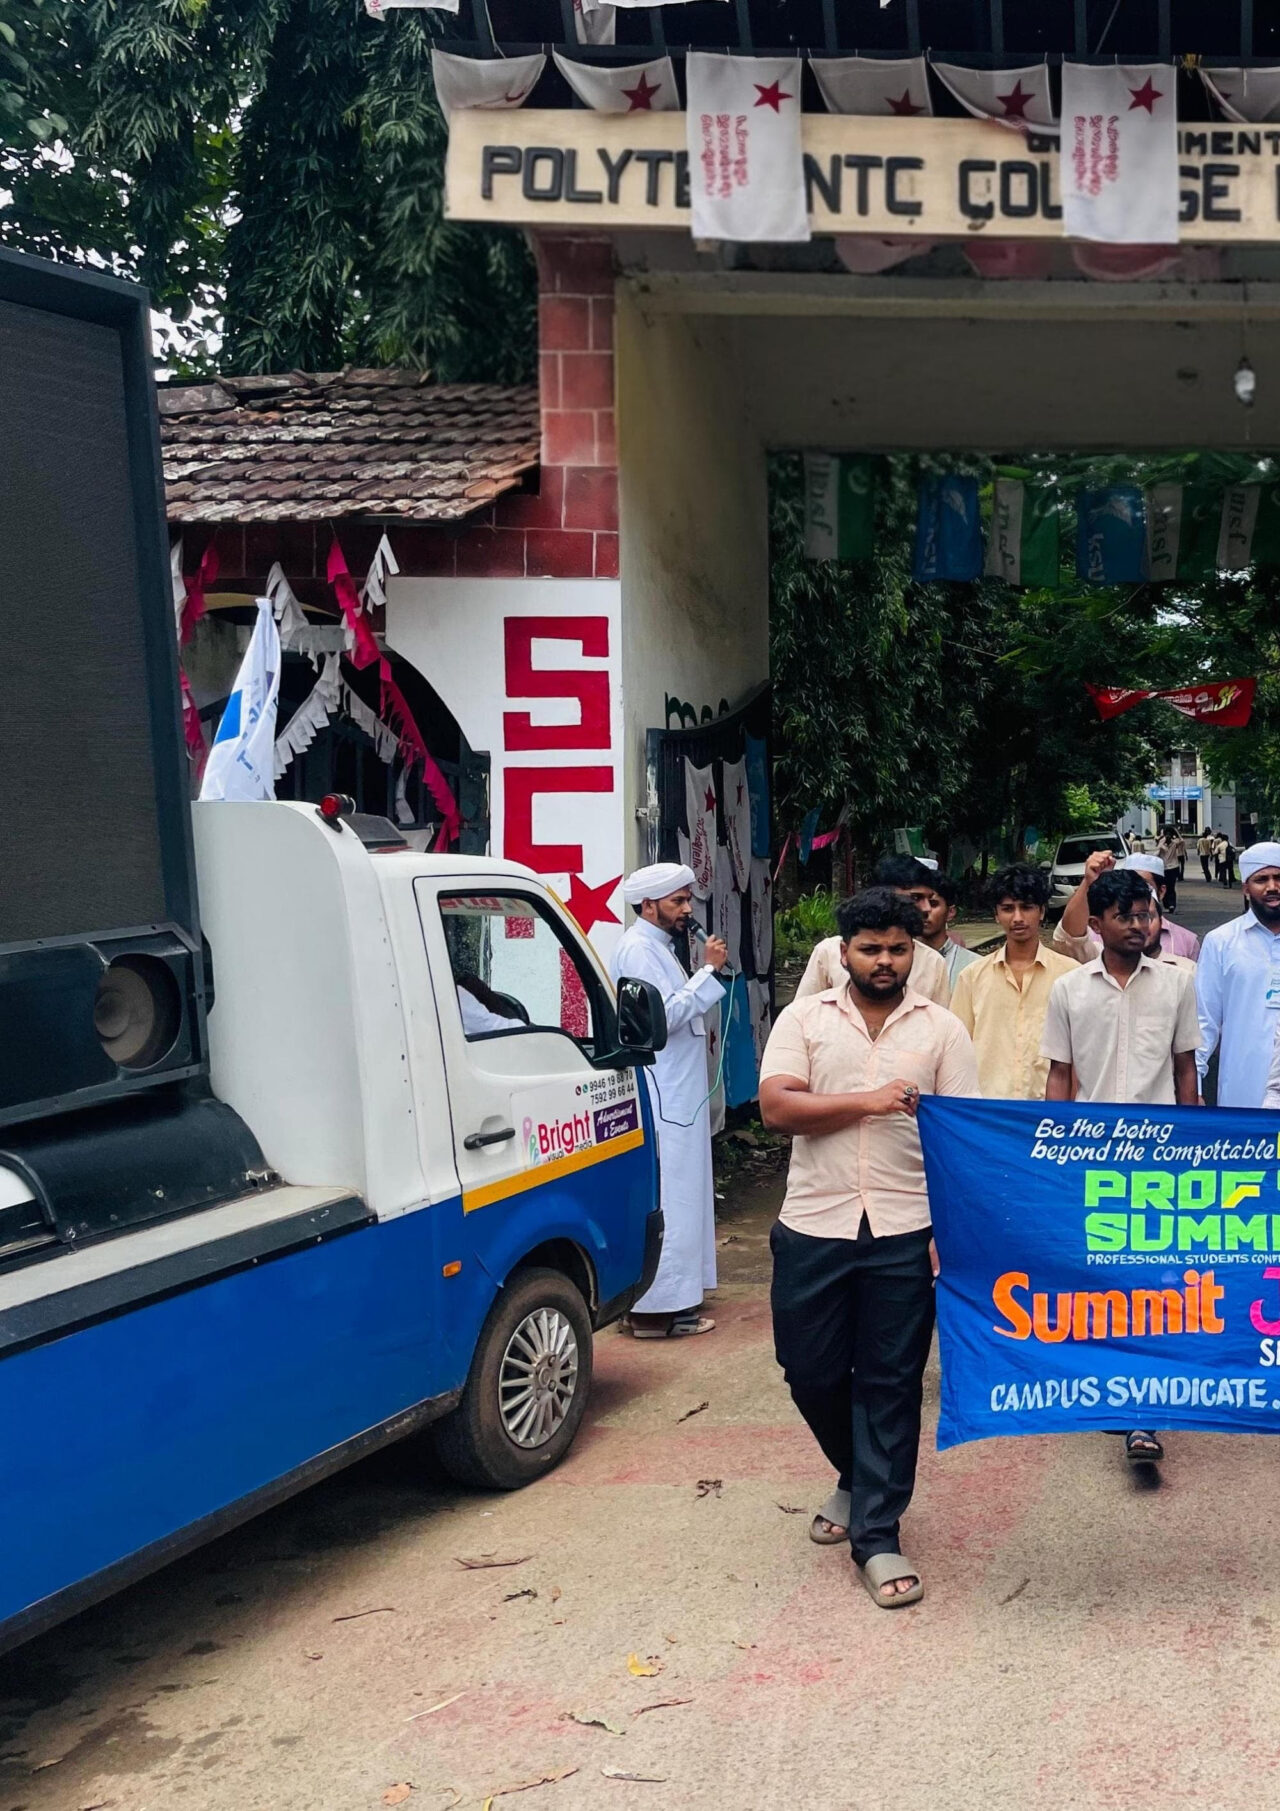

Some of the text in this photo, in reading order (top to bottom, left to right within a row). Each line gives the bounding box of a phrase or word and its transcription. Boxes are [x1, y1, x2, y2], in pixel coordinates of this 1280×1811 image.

[589, 1078, 606, 1092] 9946
[608, 1075, 615, 1086] 19
[590, 1091, 607, 1105] 7592
[608, 1089, 616, 1100] 99
[538, 1109, 592, 1154] Bright
[1034, 1117, 1174, 1144] Be the being
[1030, 1140, 1112, 1165] beyond
[1113, 1139, 1145, 1161] the
[1087, 1254, 1183, 1265] PROFESSIONAL
[1185, 1254, 1249, 1265] STUDENTS
[992, 1269, 1225, 1344] Summit
[990, 1376, 1101, 1412] CAMPUS
